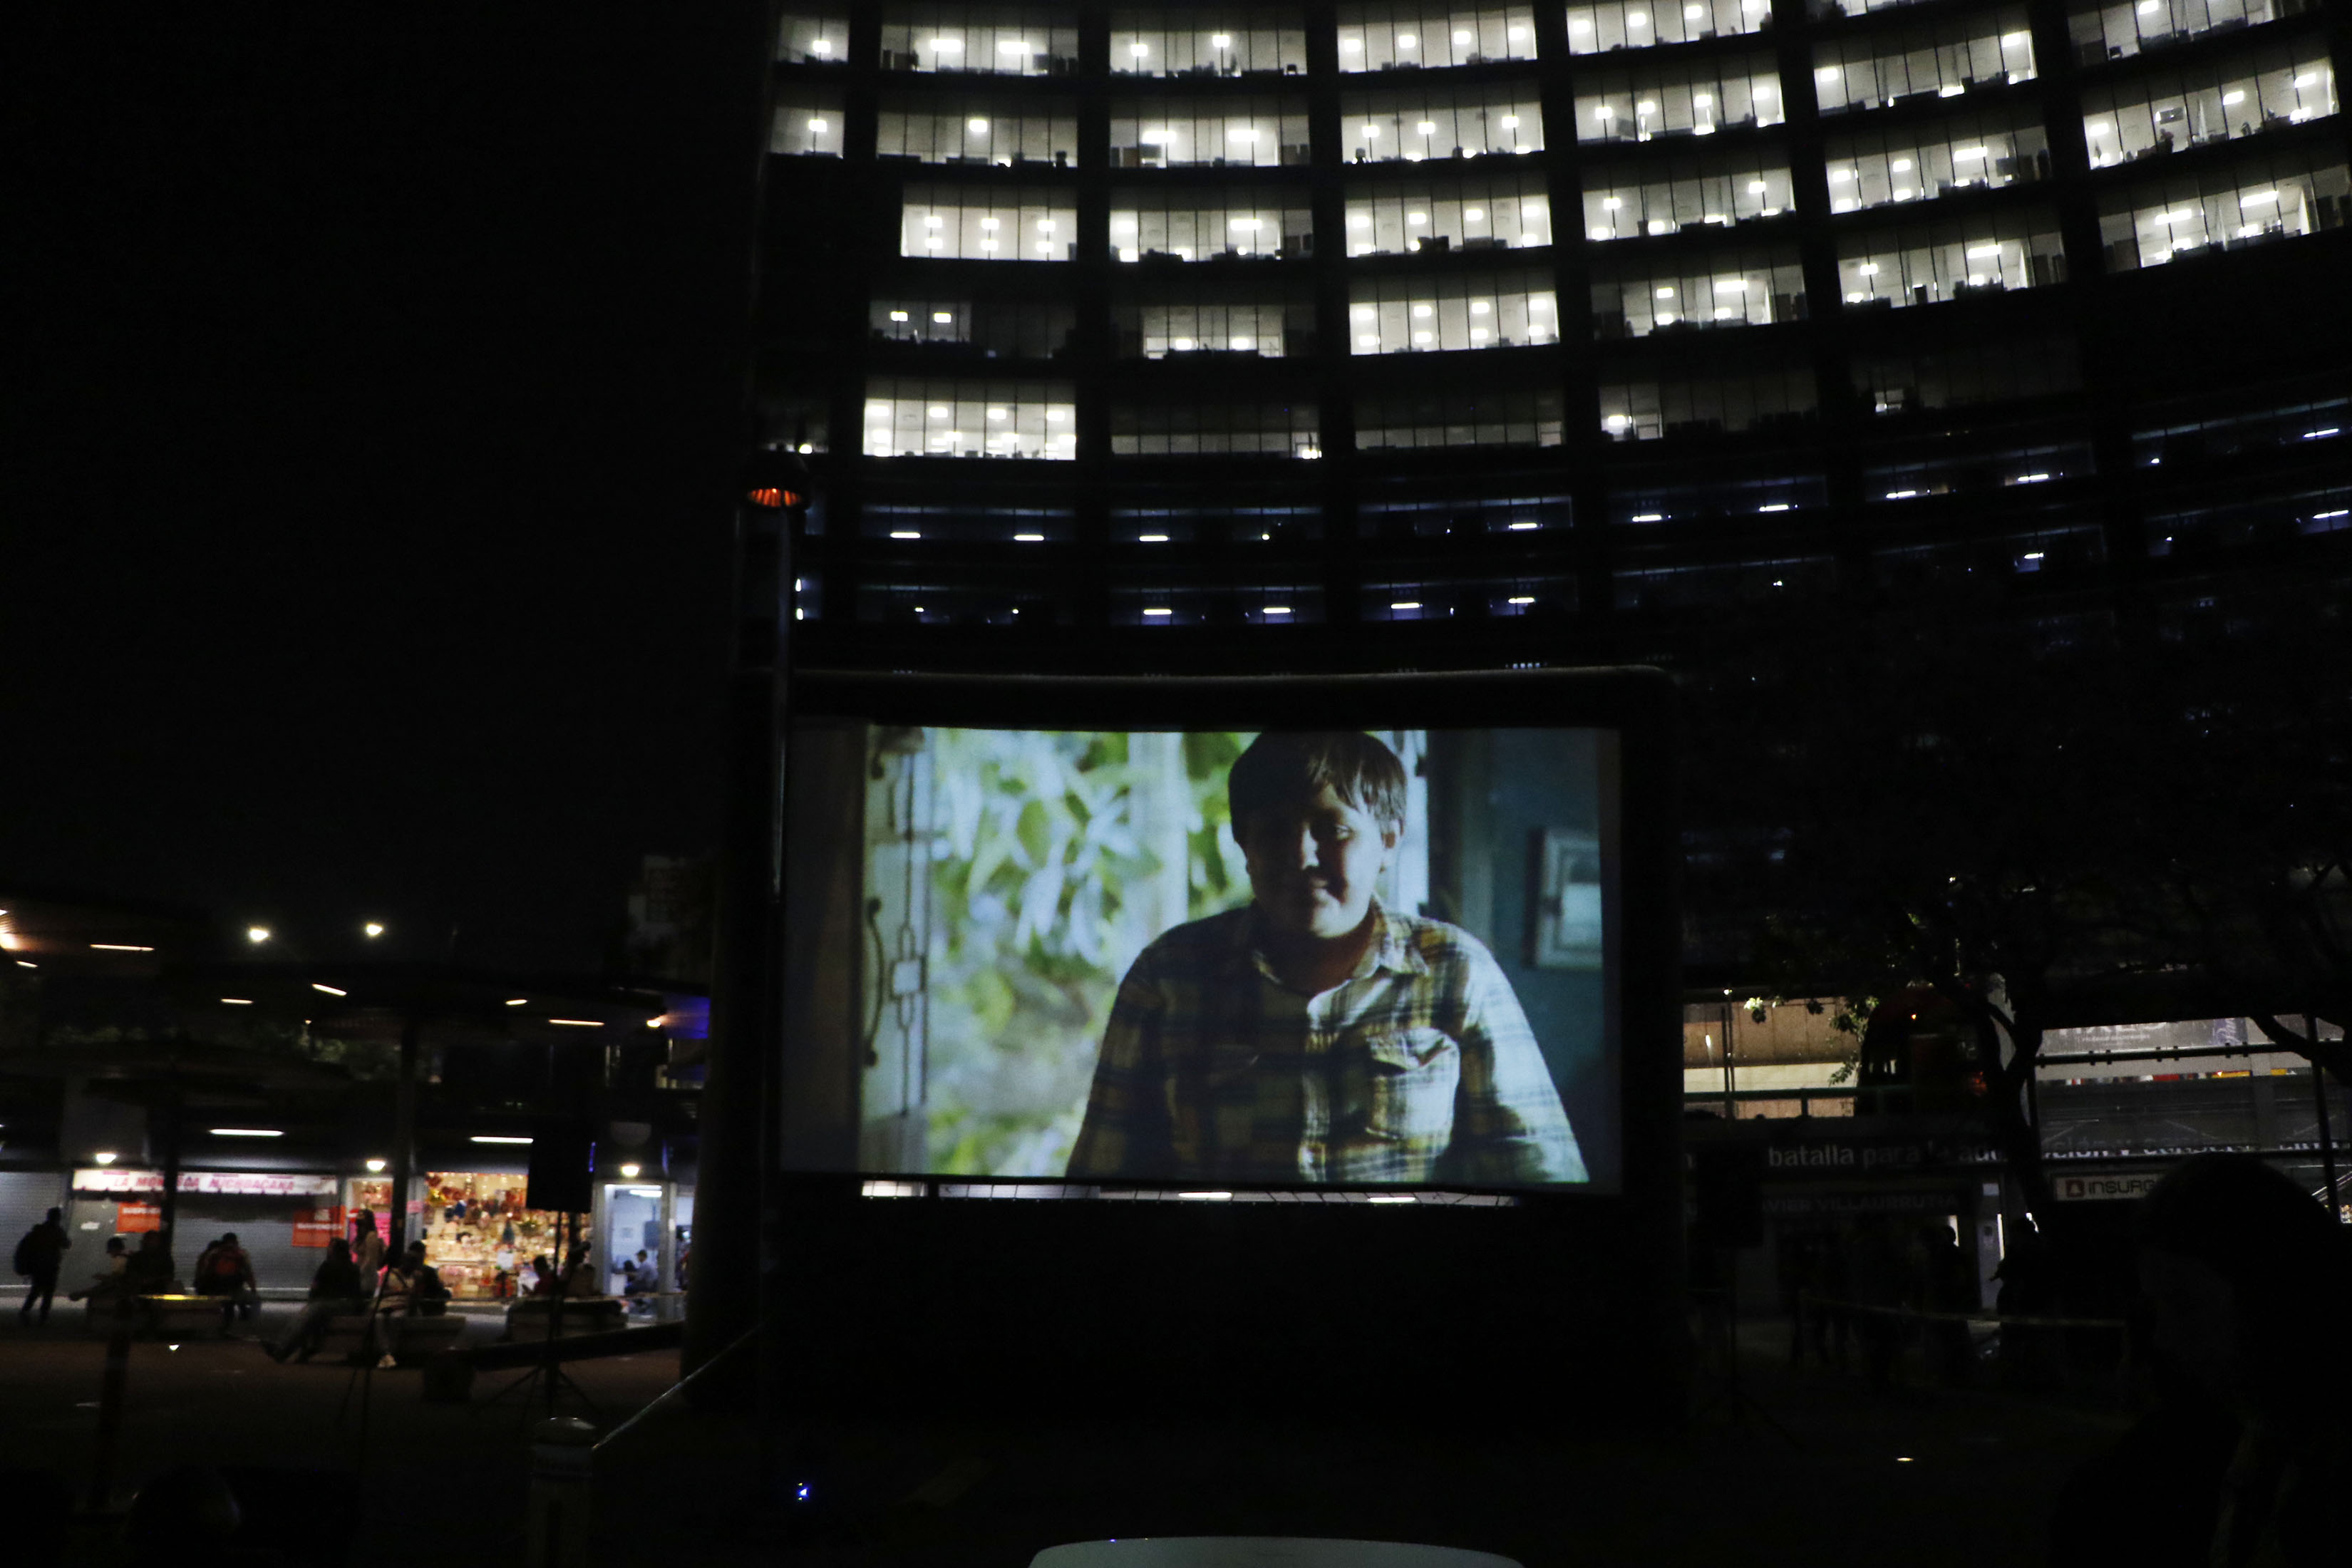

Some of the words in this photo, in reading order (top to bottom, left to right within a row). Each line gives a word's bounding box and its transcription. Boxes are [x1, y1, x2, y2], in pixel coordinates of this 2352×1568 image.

[1768, 1143, 1855, 1167] batalla
[1862, 1145, 1921, 1170] para
[2088, 1180, 2157, 1195] INSURG
